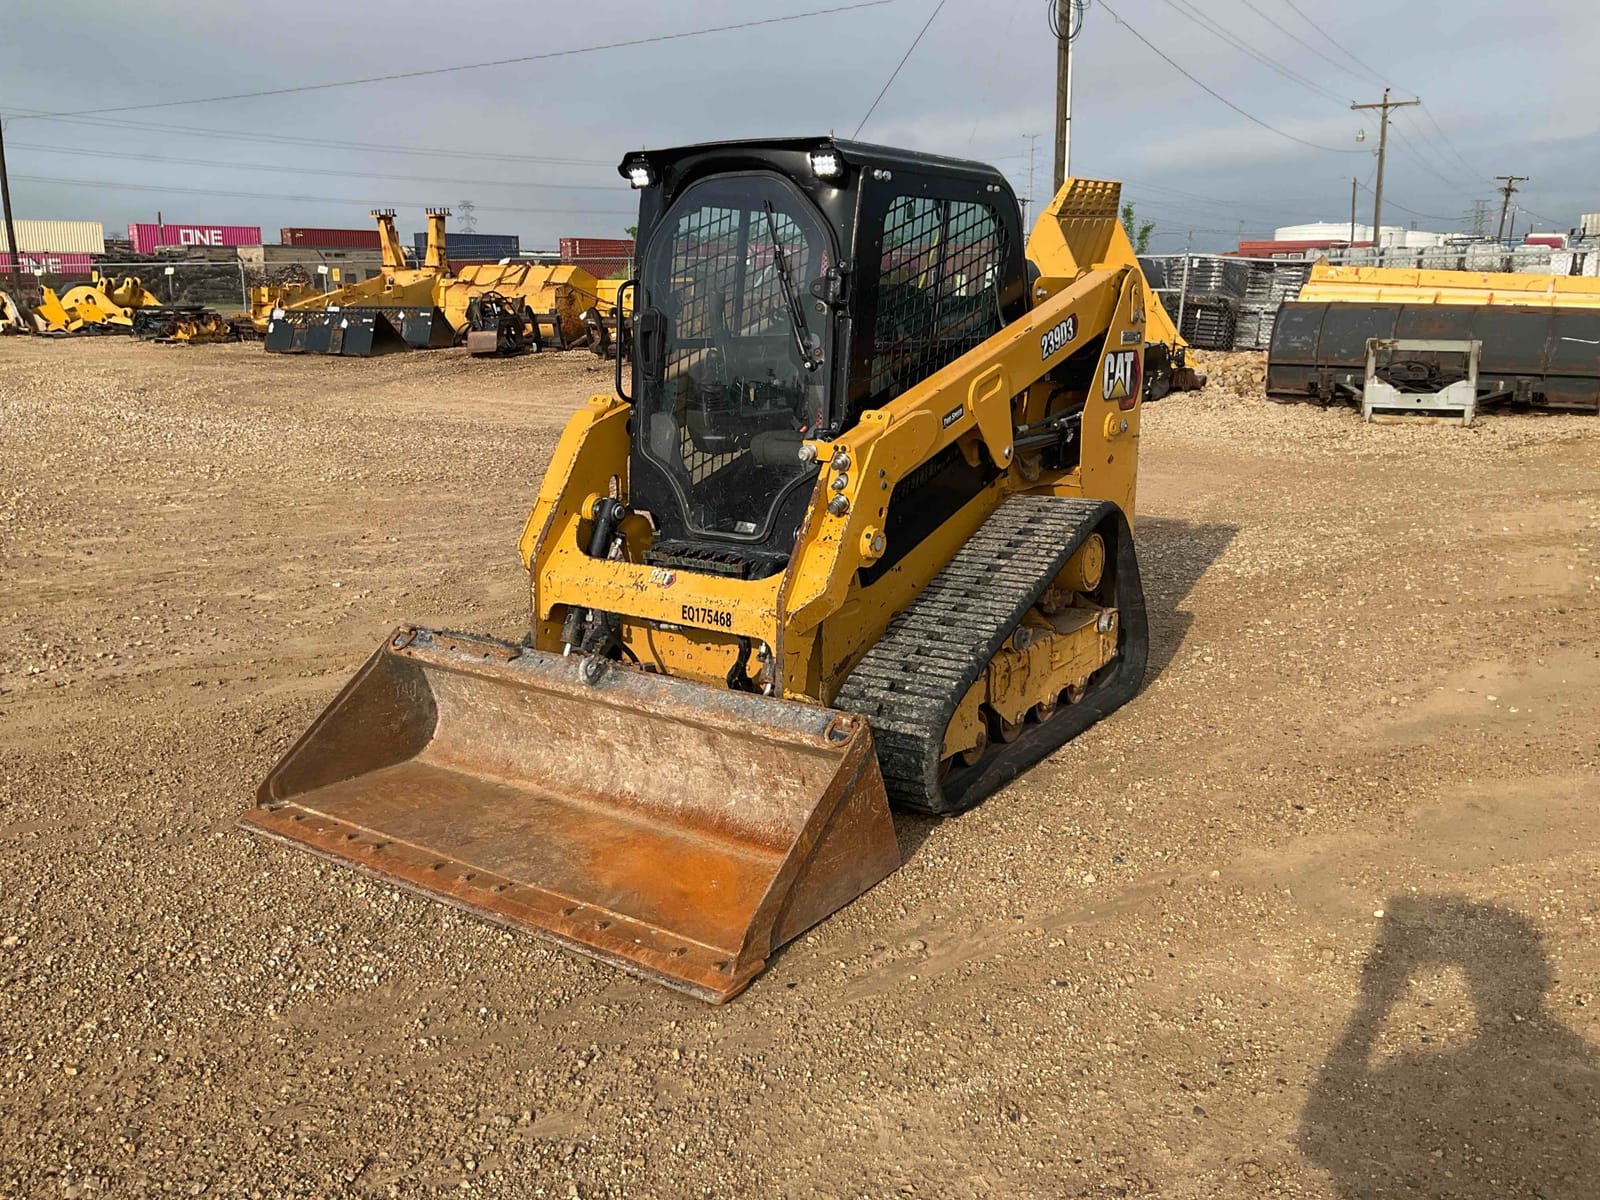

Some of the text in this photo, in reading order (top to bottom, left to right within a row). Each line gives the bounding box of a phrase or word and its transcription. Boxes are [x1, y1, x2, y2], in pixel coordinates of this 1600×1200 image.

[180, 228, 223, 246] ONE
[1041, 317, 1074, 359] 239D3
[1103, 352, 1134, 400] CAT
[682, 605, 731, 627] EQ175468
